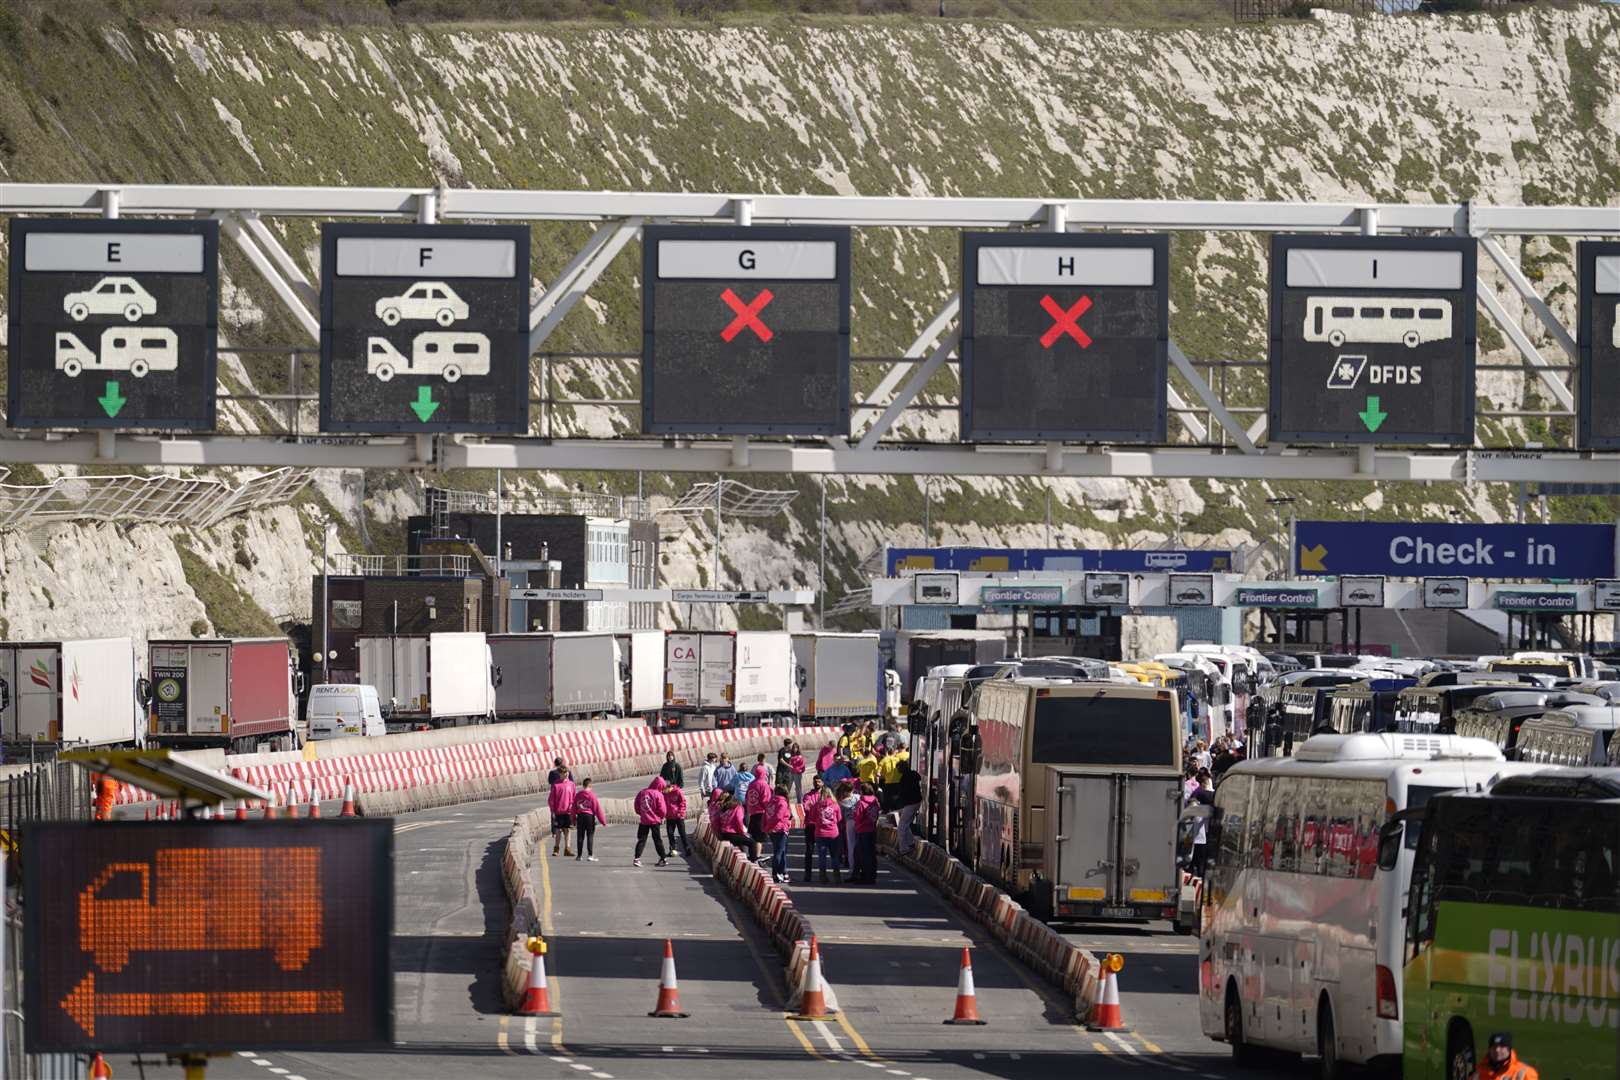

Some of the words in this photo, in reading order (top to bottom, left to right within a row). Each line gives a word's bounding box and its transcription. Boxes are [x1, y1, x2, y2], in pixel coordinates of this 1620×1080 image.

[107, 242, 121, 262] E
[419, 247, 432, 267] F
[738, 249, 756, 270] G
[1058, 256, 1075, 276] H
[1372, 259, 1378, 279] I
[1369, 365, 1422, 385] DFDS
[1389, 536, 1494, 565] Check
[1527, 537, 1556, 565] in
[984, 591, 1021, 600] Frontier
[1024, 591, 1060, 600] Control
[1240, 593, 1277, 603] Frontier
[1279, 594, 1315, 603] Control
[1499, 597, 1537, 606] Frontier
[1539, 597, 1574, 606] Control
